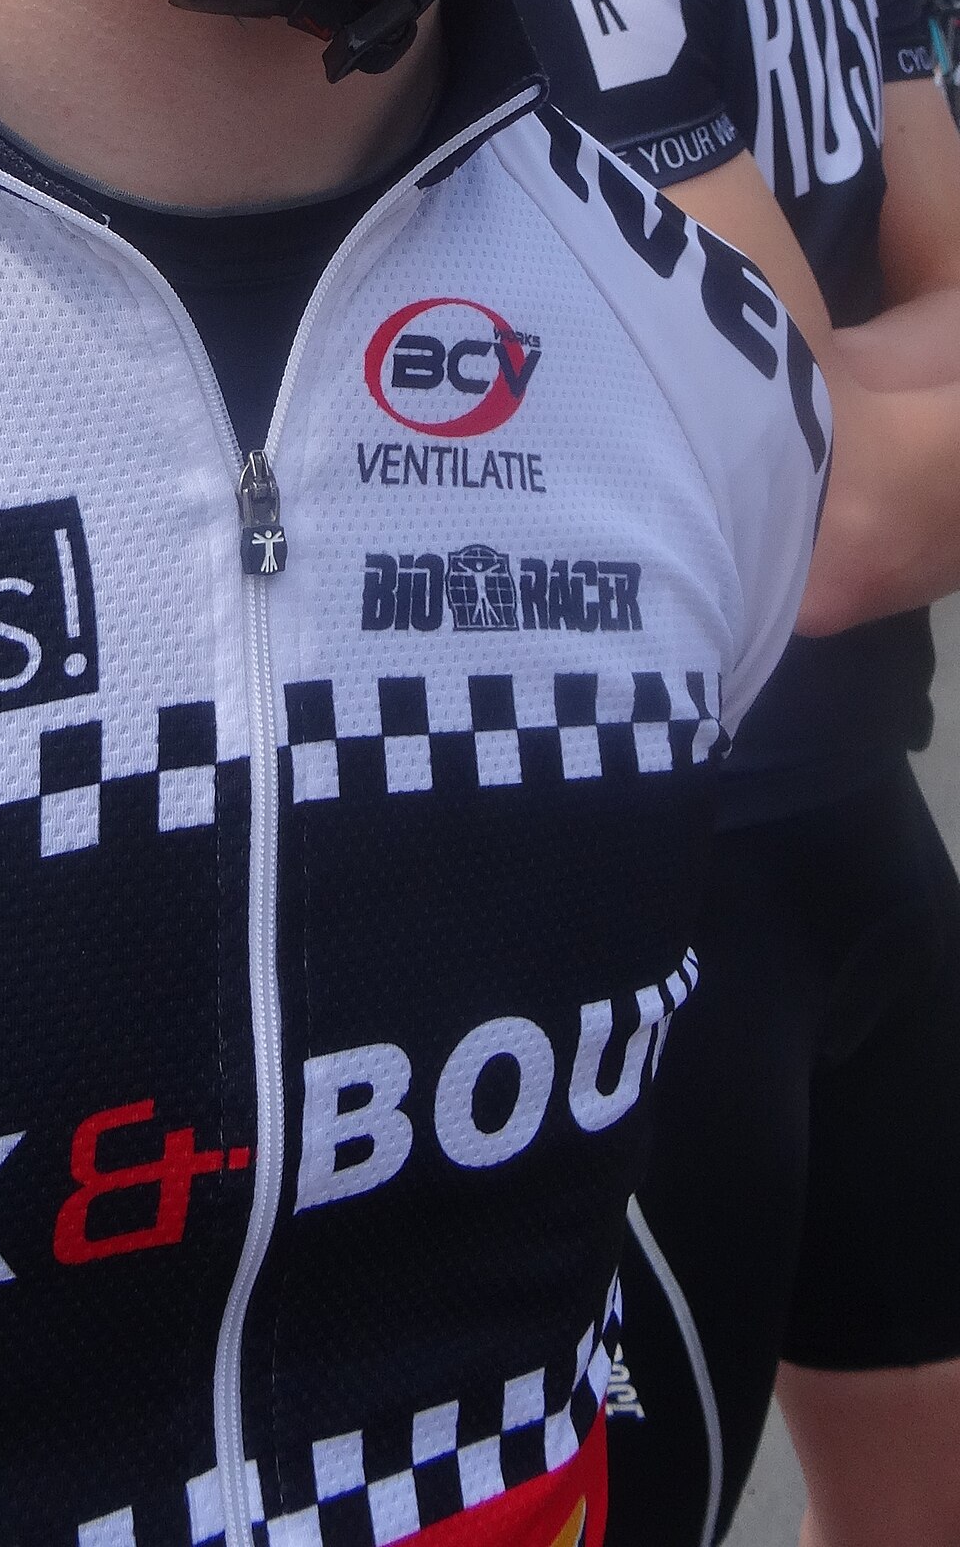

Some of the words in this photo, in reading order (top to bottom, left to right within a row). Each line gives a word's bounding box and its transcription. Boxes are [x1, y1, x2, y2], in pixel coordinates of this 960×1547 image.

[637, 125, 717, 174] YOUR
[493, 328, 540, 347] WORKS
[390, 334, 542, 399] BCV
[356, 442, 547, 494] VENTILATIE
